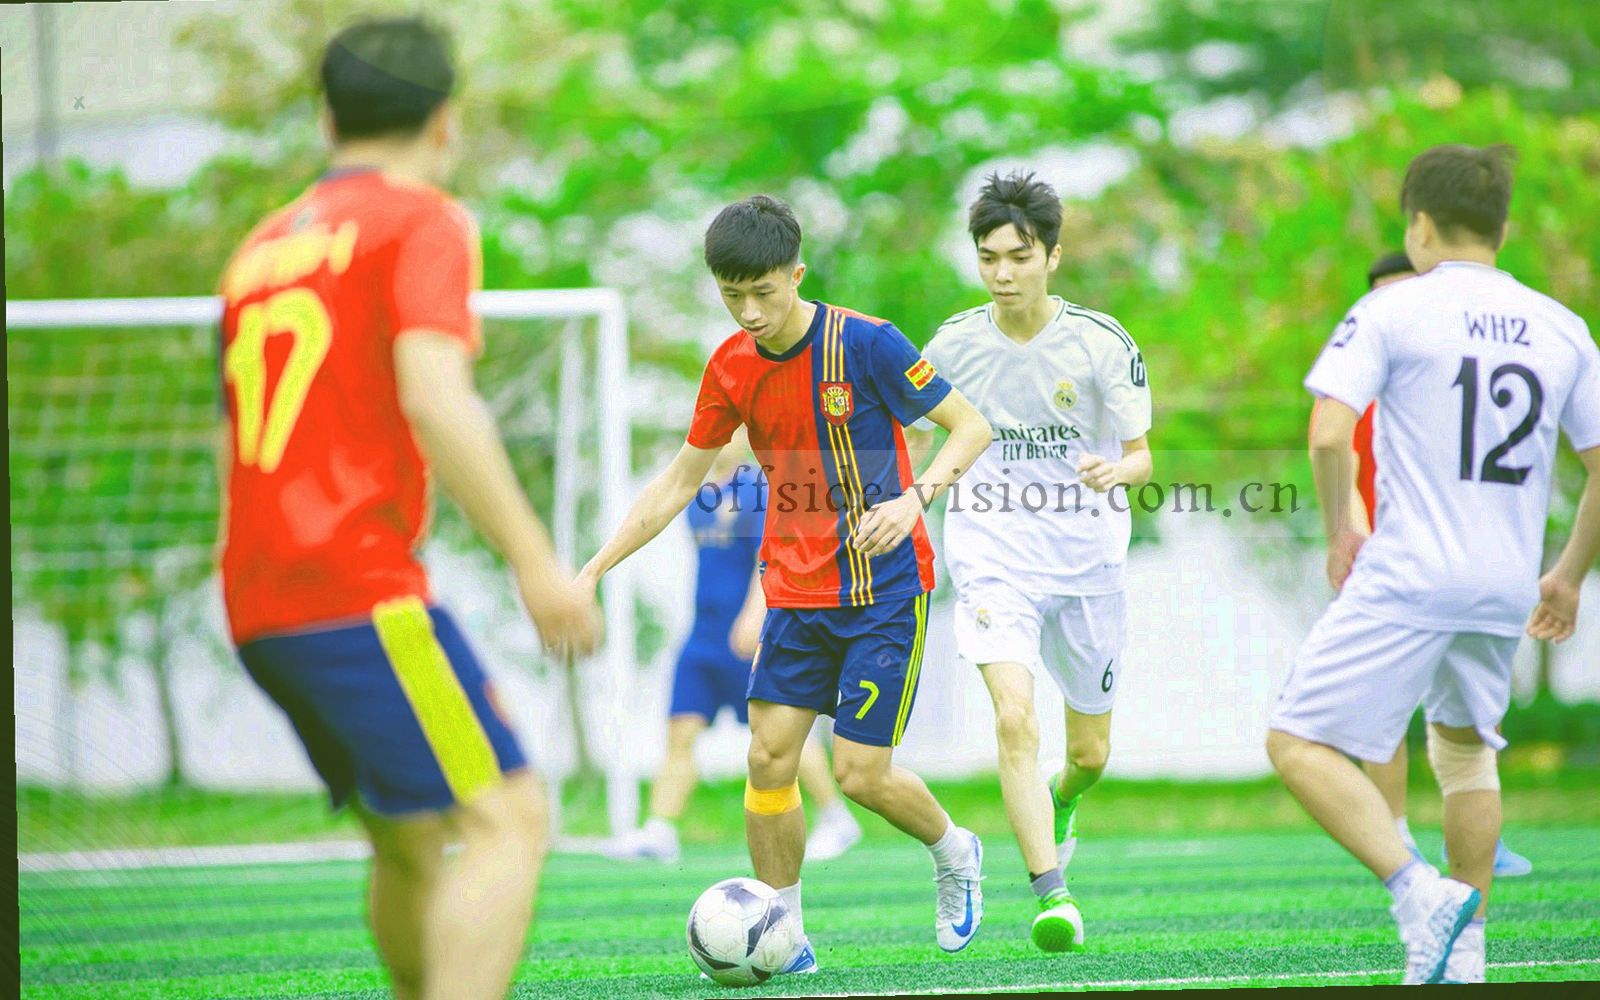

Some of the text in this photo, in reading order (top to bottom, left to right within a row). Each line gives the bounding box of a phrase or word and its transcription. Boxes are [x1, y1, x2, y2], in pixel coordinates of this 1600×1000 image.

[1465, 311, 1530, 346] WH2
[225, 288, 332, 473] 17
[1452, 356, 1543, 485] 12
[1003, 443, 1021, 461] FLY
[1101, 658, 1114, 693] 6
[855, 680, 880, 720] 7
